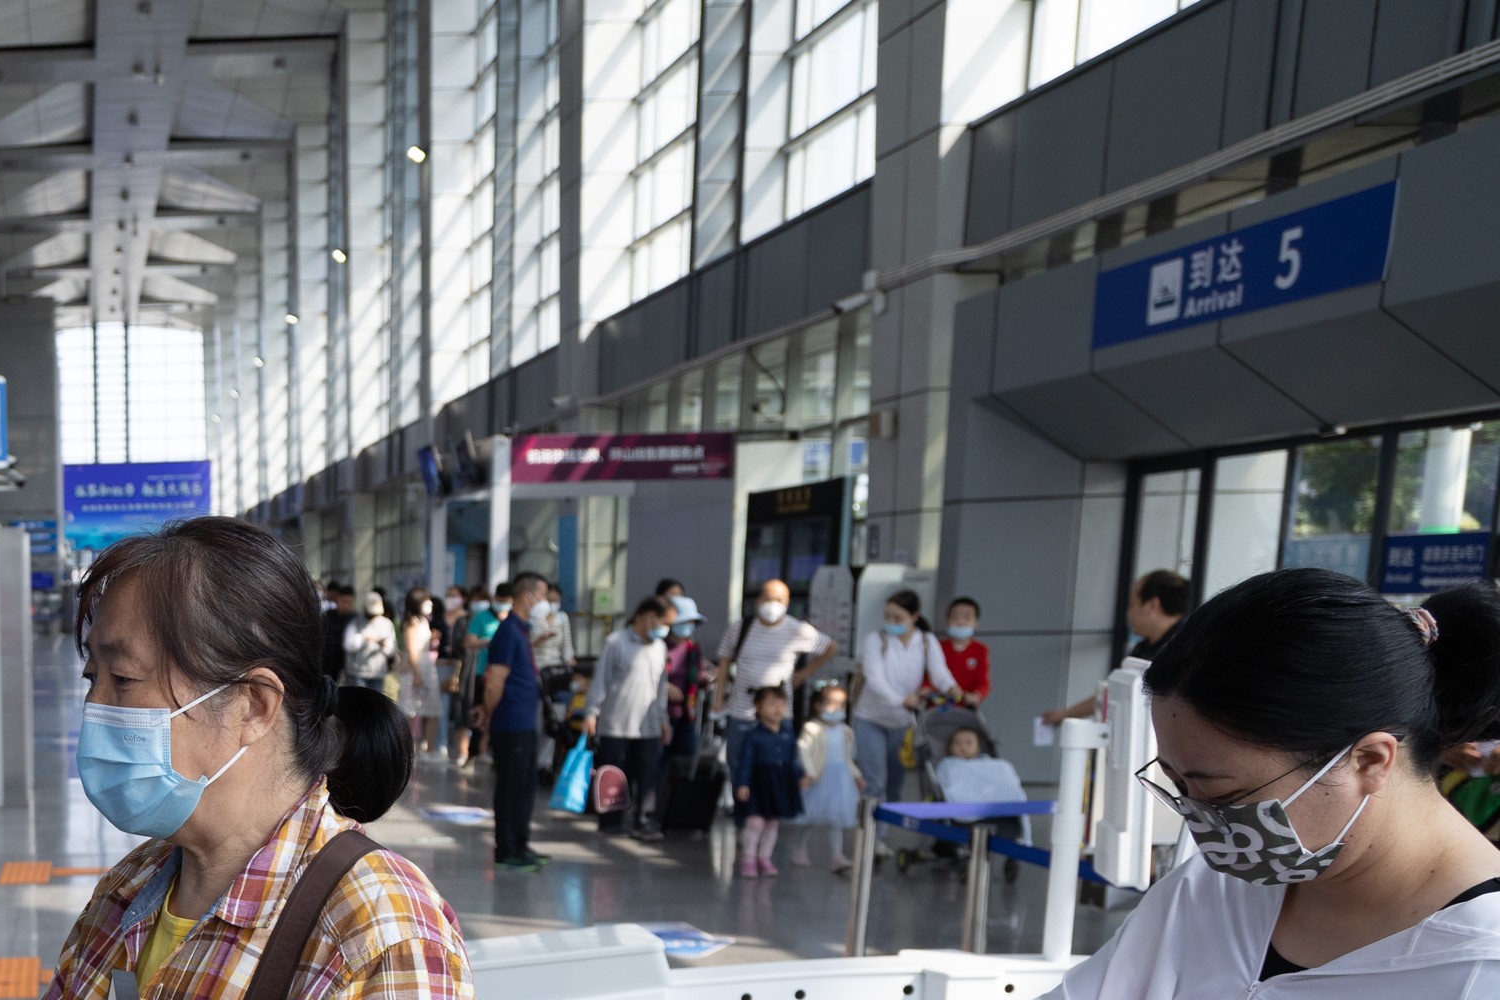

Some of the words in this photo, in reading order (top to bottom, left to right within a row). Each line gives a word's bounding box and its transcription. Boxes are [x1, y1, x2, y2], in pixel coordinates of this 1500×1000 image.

[1189, 238, 1244, 290] 到达
[1274, 226, 1303, 290] 5
[1183, 284, 1244, 319] Arrival
